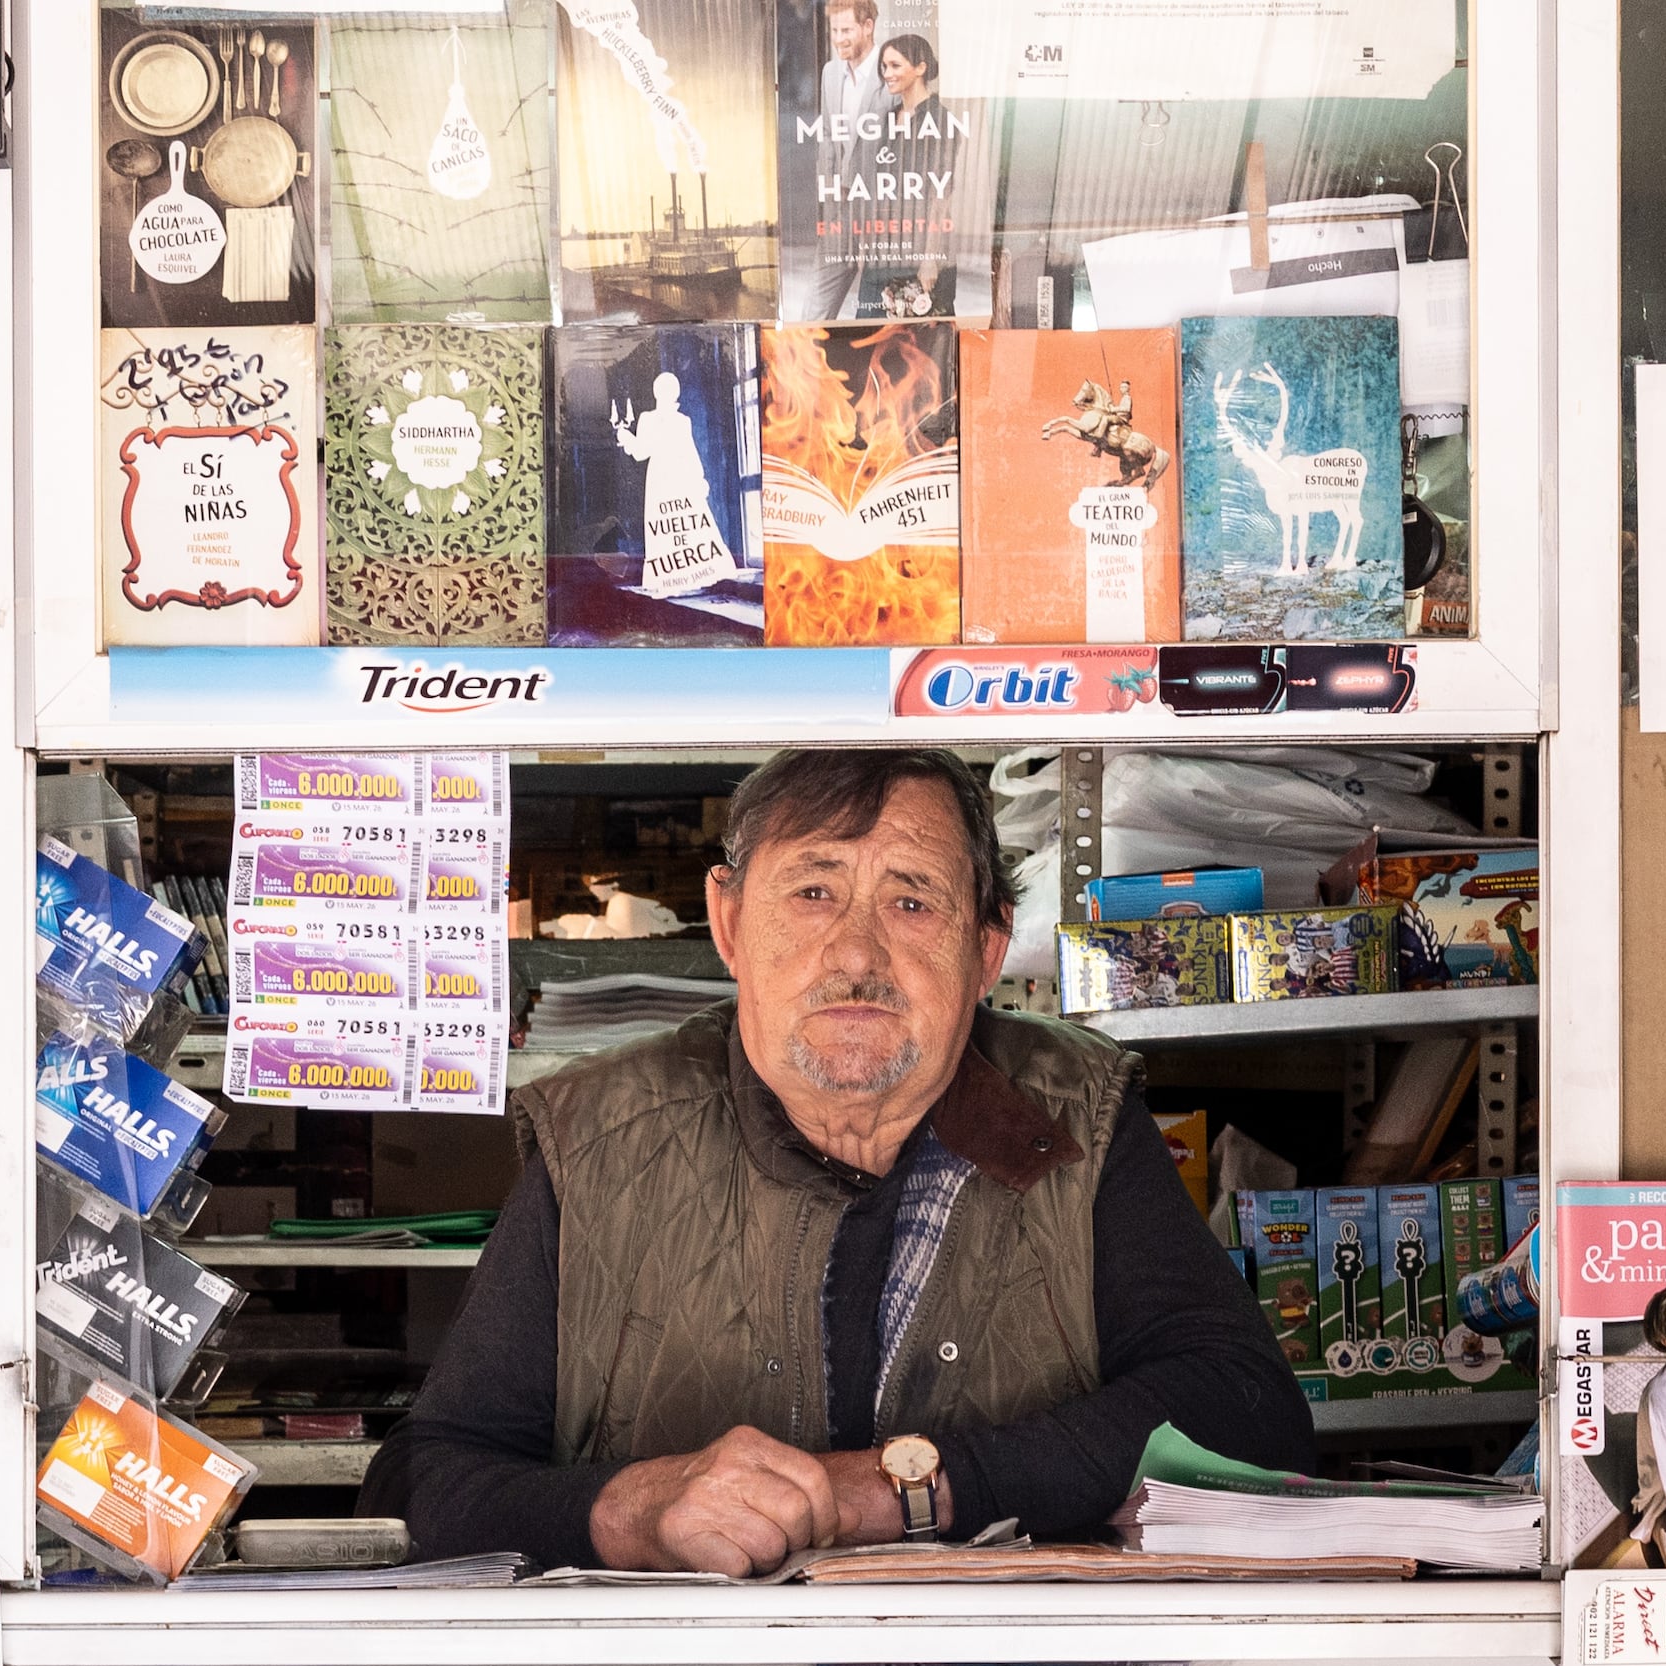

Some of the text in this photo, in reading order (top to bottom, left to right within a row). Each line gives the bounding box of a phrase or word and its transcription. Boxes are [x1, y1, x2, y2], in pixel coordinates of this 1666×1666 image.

[795, 111, 971, 143] MEGHAN
[818, 171, 953, 203] HARRY
[140, 227, 219, 251] CHOCOLATE
[400, 426, 474, 438] SIDDHARTHA
[1305, 476, 1358, 487] ESTOCOLMO
[860, 483, 951, 523] FAHRENHEIT
[897, 506, 925, 528] 451
[1083, 506, 1143, 520] TEATRO
[646, 541, 722, 577] TUERCA
[361, 667, 545, 704] Trident
[929, 670, 1073, 706] Orbit
[337, 924, 400, 940] 70581
